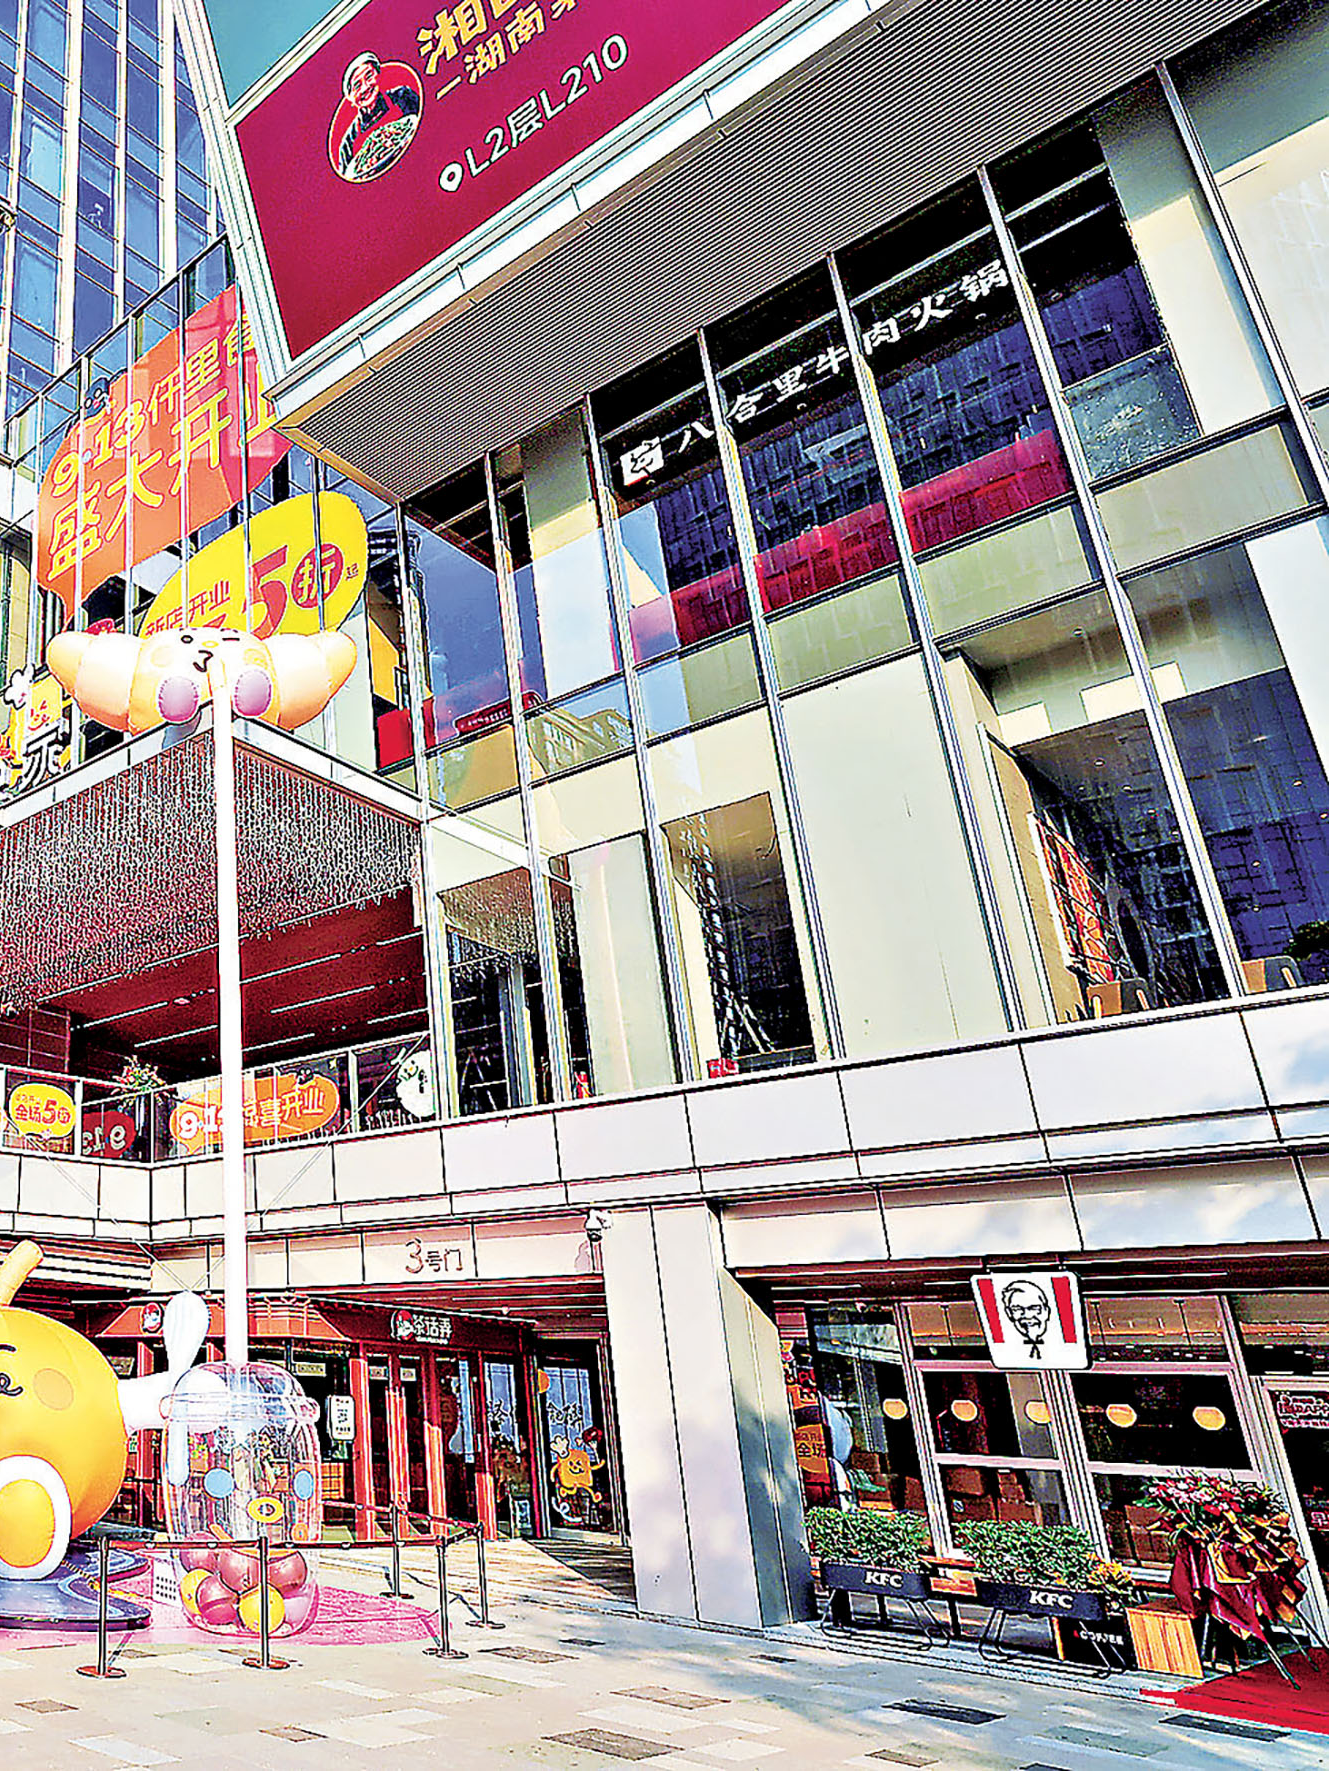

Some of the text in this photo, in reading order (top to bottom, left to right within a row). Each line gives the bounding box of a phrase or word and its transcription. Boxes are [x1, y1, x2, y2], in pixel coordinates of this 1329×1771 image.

[416, 0, 518, 76] 湘
[677, 259, 1009, 453] 八合里牛肉火锅
[405, 1238, 463, 1273] 3号门
[864, 1570, 903, 1588] KFC
[1028, 1590, 1074, 1609] KFC
